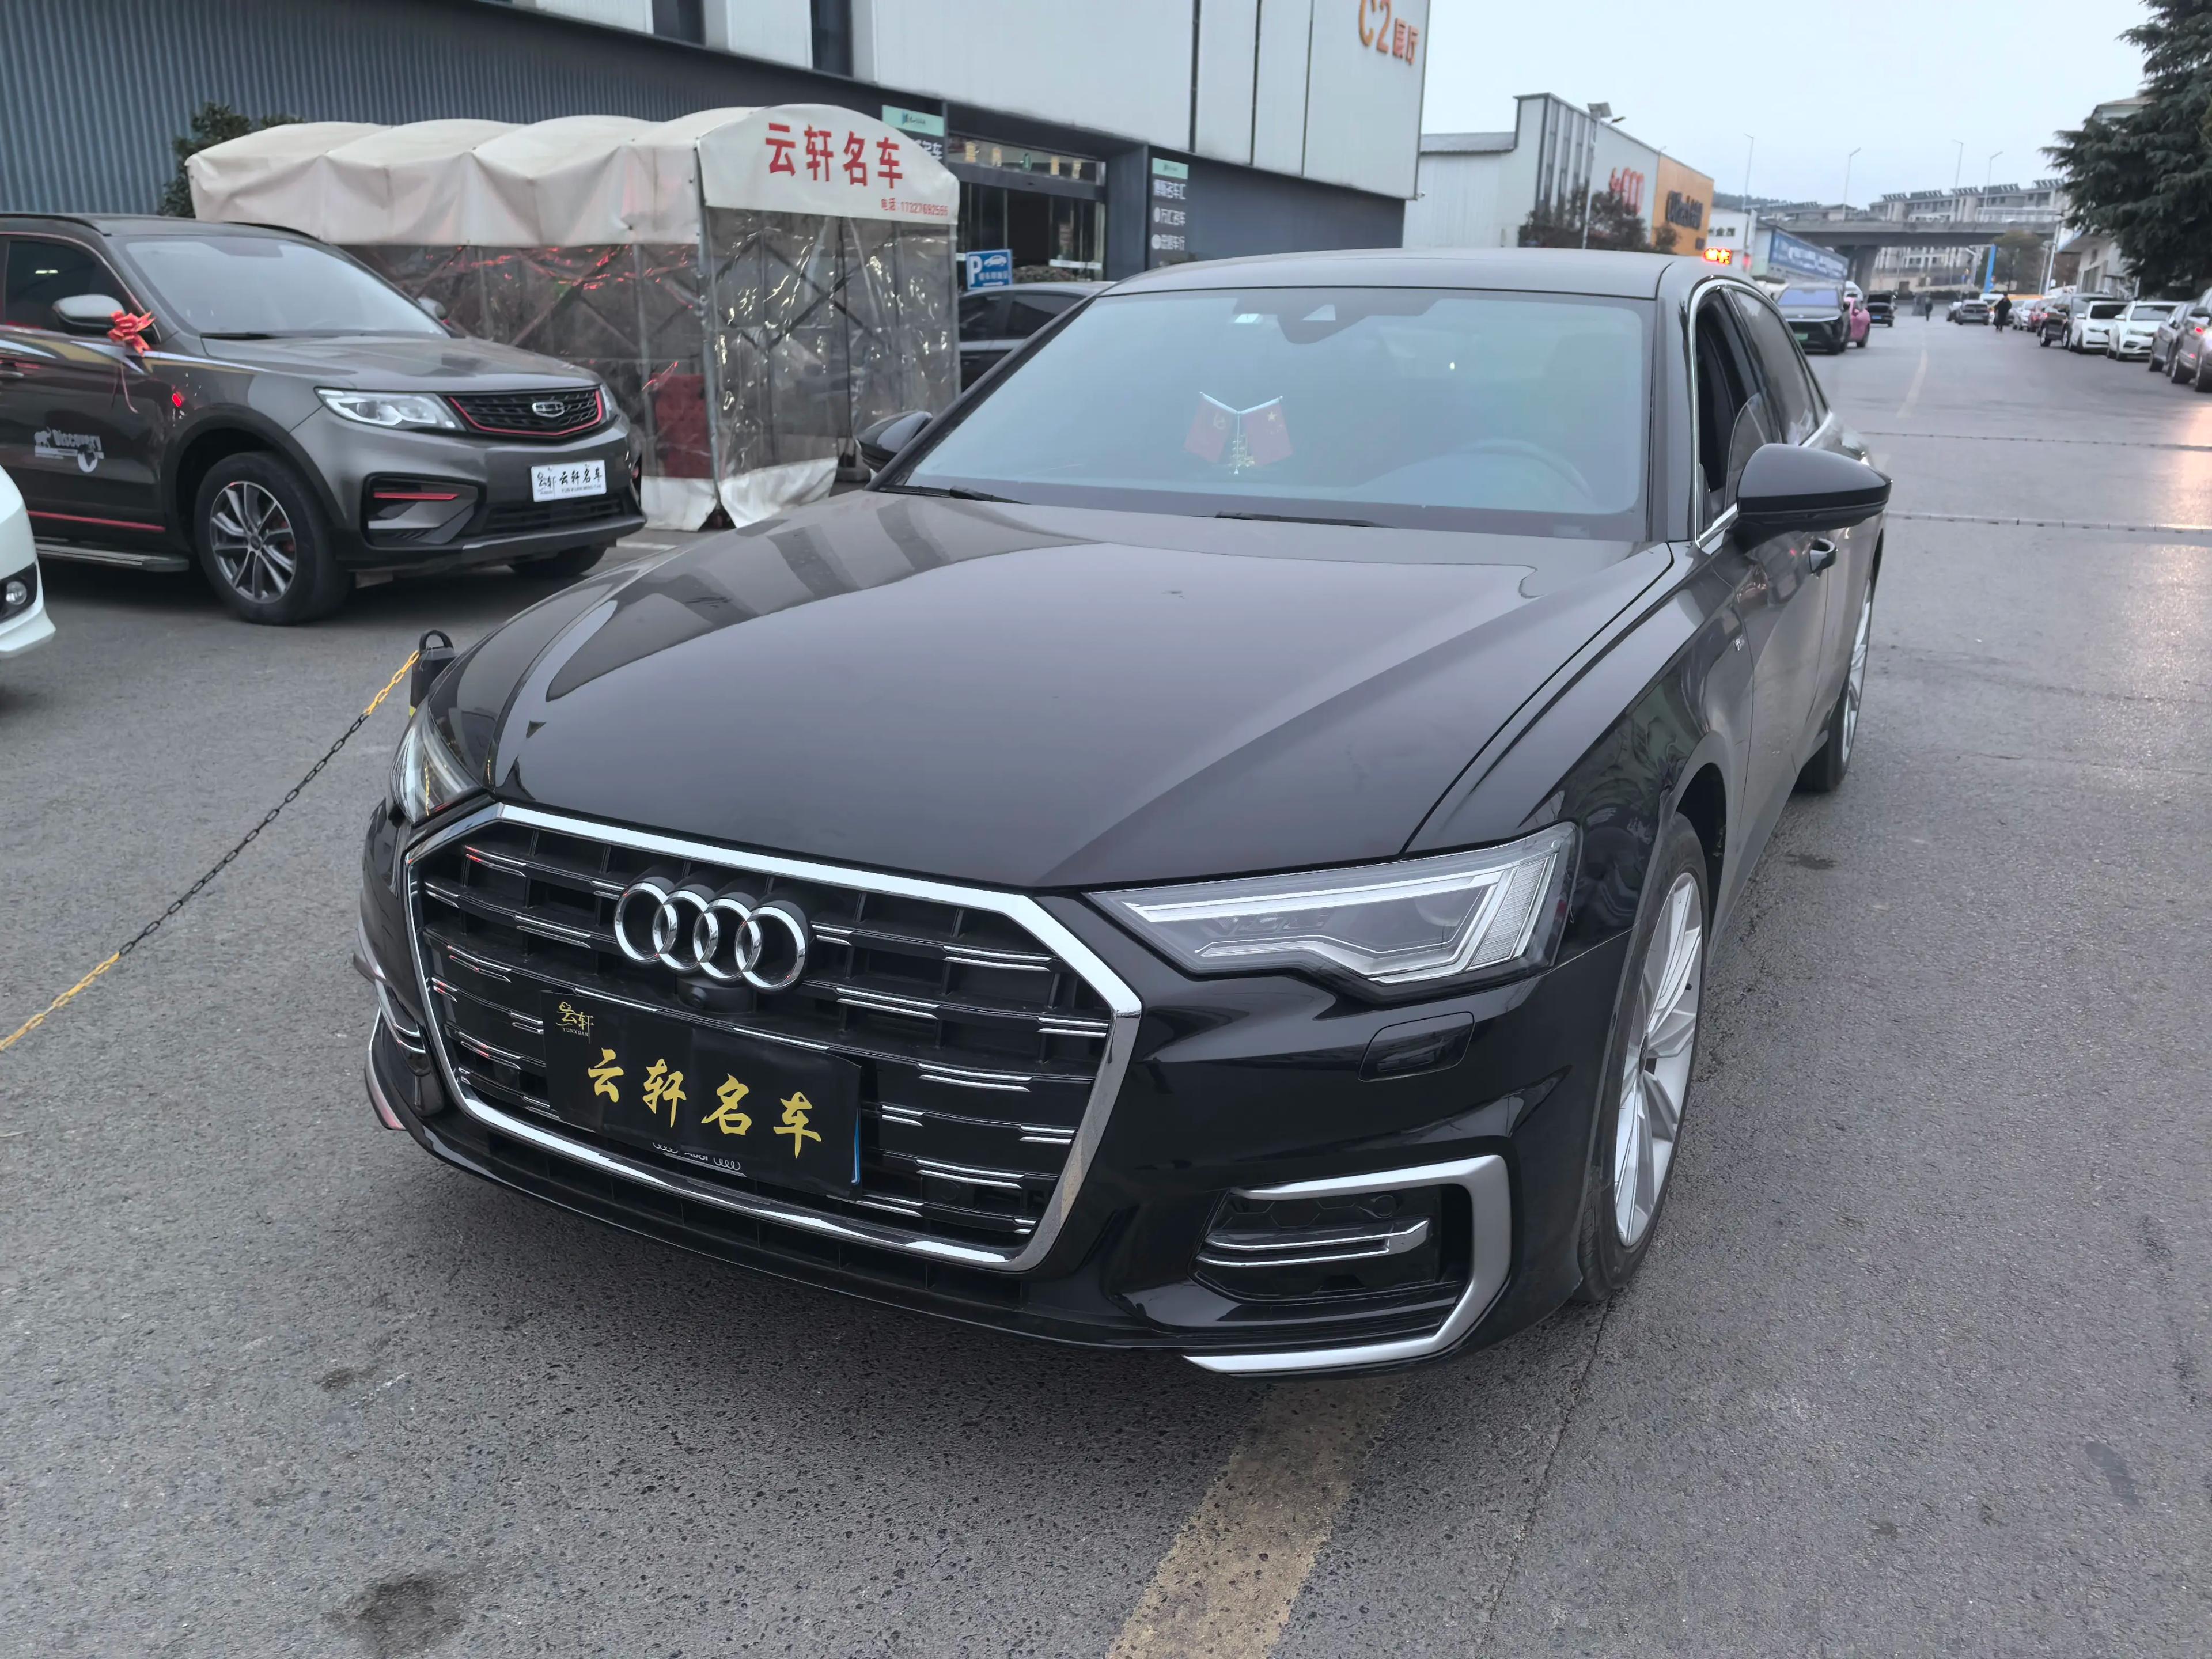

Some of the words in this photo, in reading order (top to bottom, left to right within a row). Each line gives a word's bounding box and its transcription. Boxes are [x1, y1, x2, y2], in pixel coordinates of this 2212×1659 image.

[765, 122, 903, 189] 云轩名车
[969, 255, 982, 285] P
[559, 467, 603, 485] 云轩名车
[562, 1027, 589, 1037] YUNXUAN
[588, 1047, 822, 1159] 云轩名车
